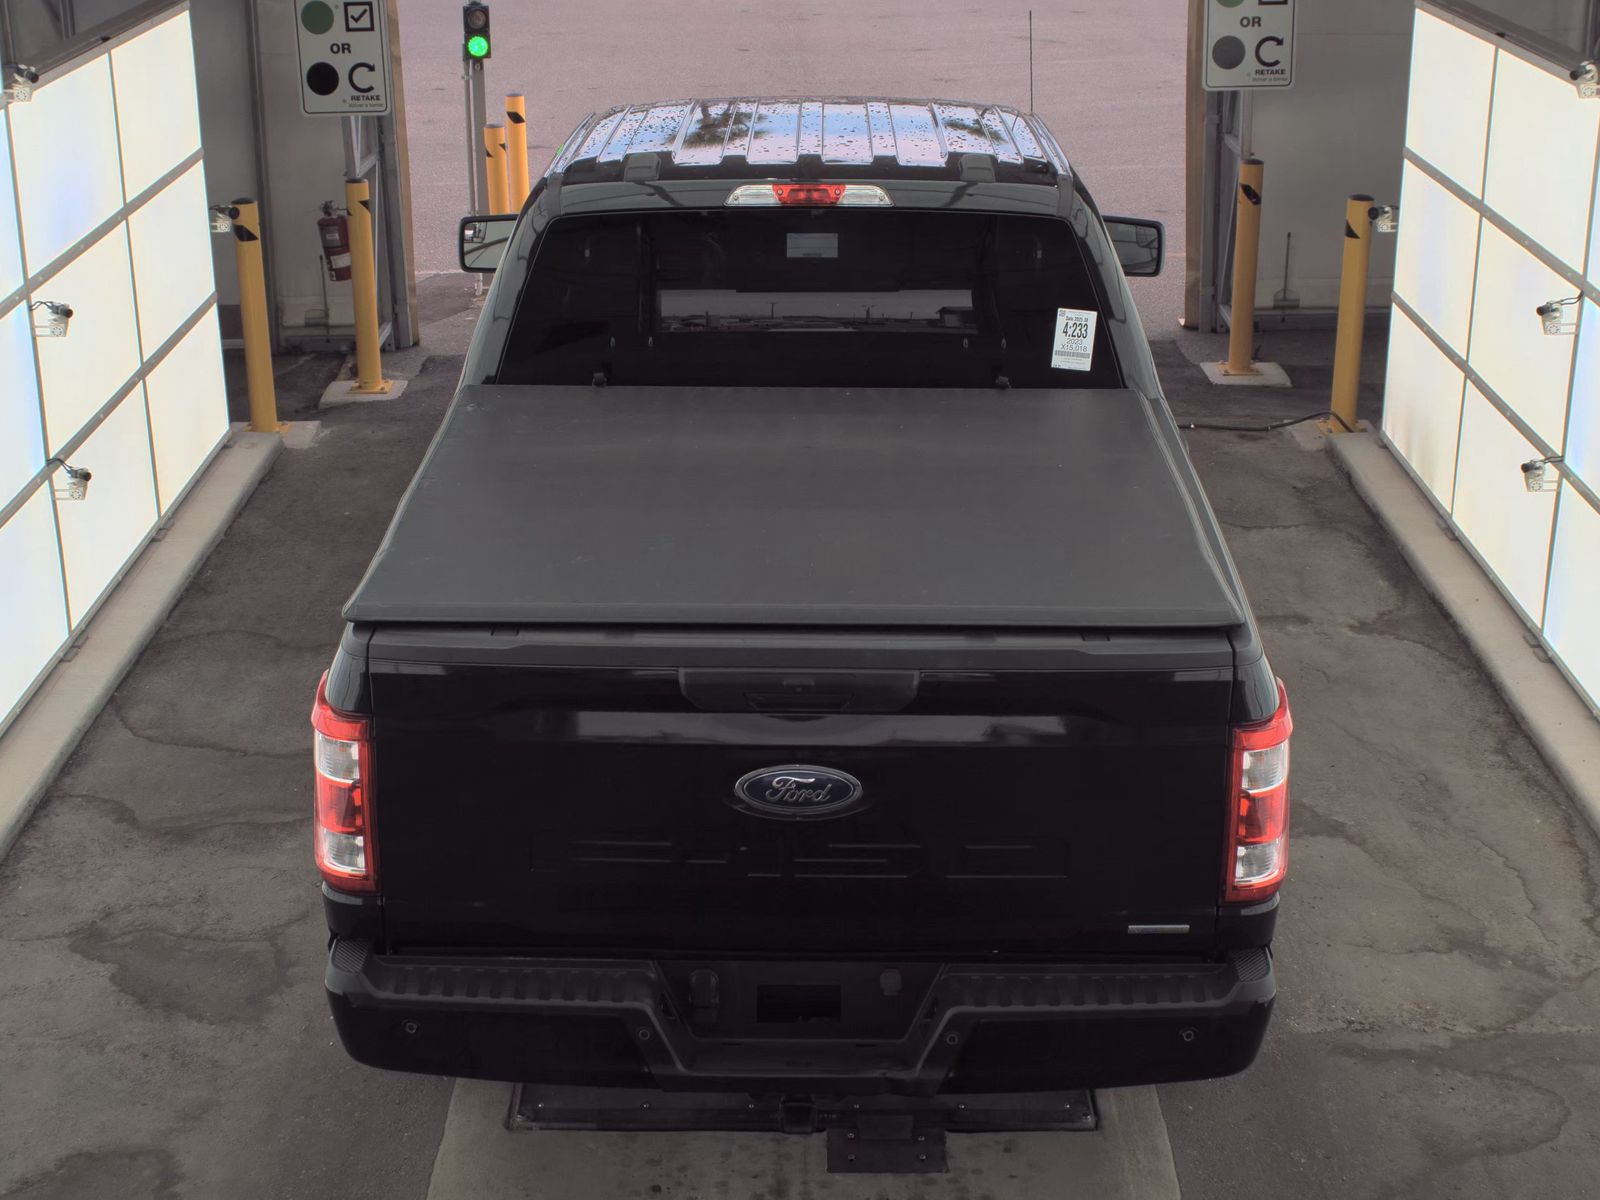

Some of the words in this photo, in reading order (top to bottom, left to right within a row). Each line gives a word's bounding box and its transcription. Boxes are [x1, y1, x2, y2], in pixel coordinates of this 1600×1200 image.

[1240, 16, 1262, 28] OR
[330, 43, 352, 54] OR
[1062, 321, 1089, 339] 4:233
[1066, 338, 1083, 346] 2023
[765, 776, 833, 802] Ford
